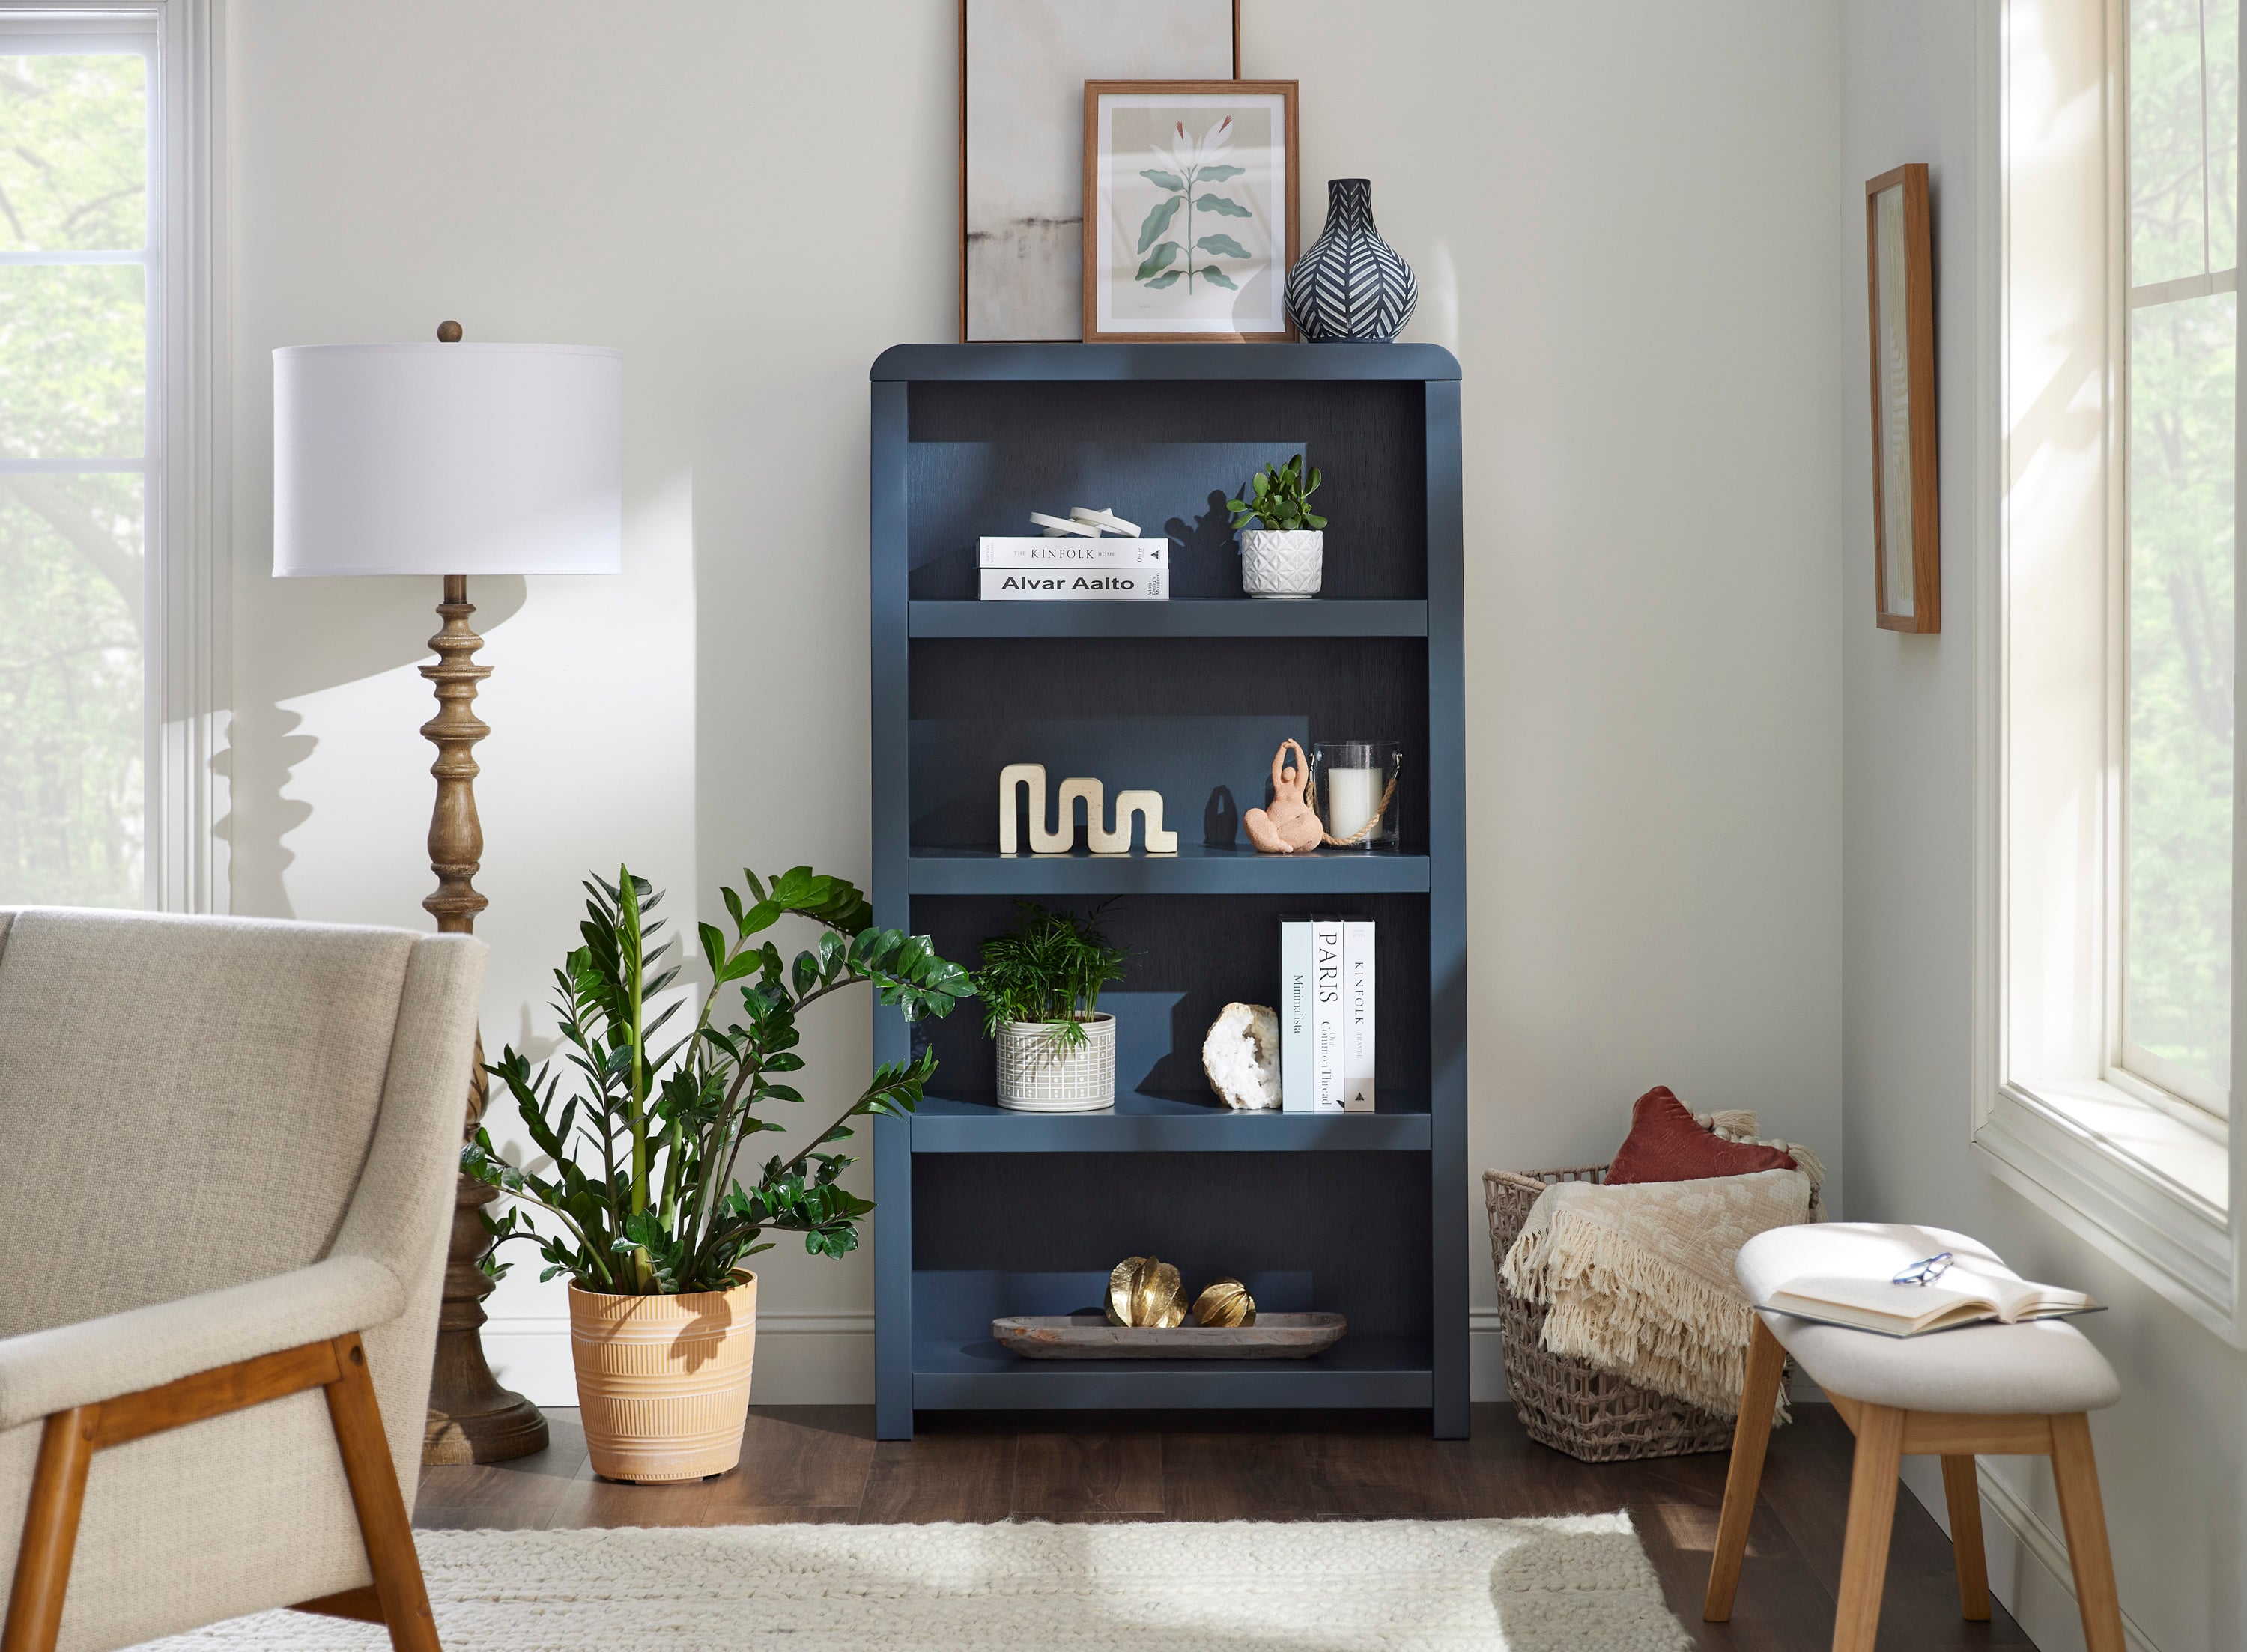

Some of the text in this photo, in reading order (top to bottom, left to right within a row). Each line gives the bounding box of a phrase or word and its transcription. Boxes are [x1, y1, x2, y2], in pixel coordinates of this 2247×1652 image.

[1001, 577, 1134, 589] Alvar Aalto
[1031, 550, 1094, 559] KINFOLK
[1319, 933, 1338, 1003] PARIS
[1354, 962, 1364, 1024] KINFOLK
[1294, 975, 1303, 1033] Minimalista
[1321, 1021, 1332, 1105] Common Thread
